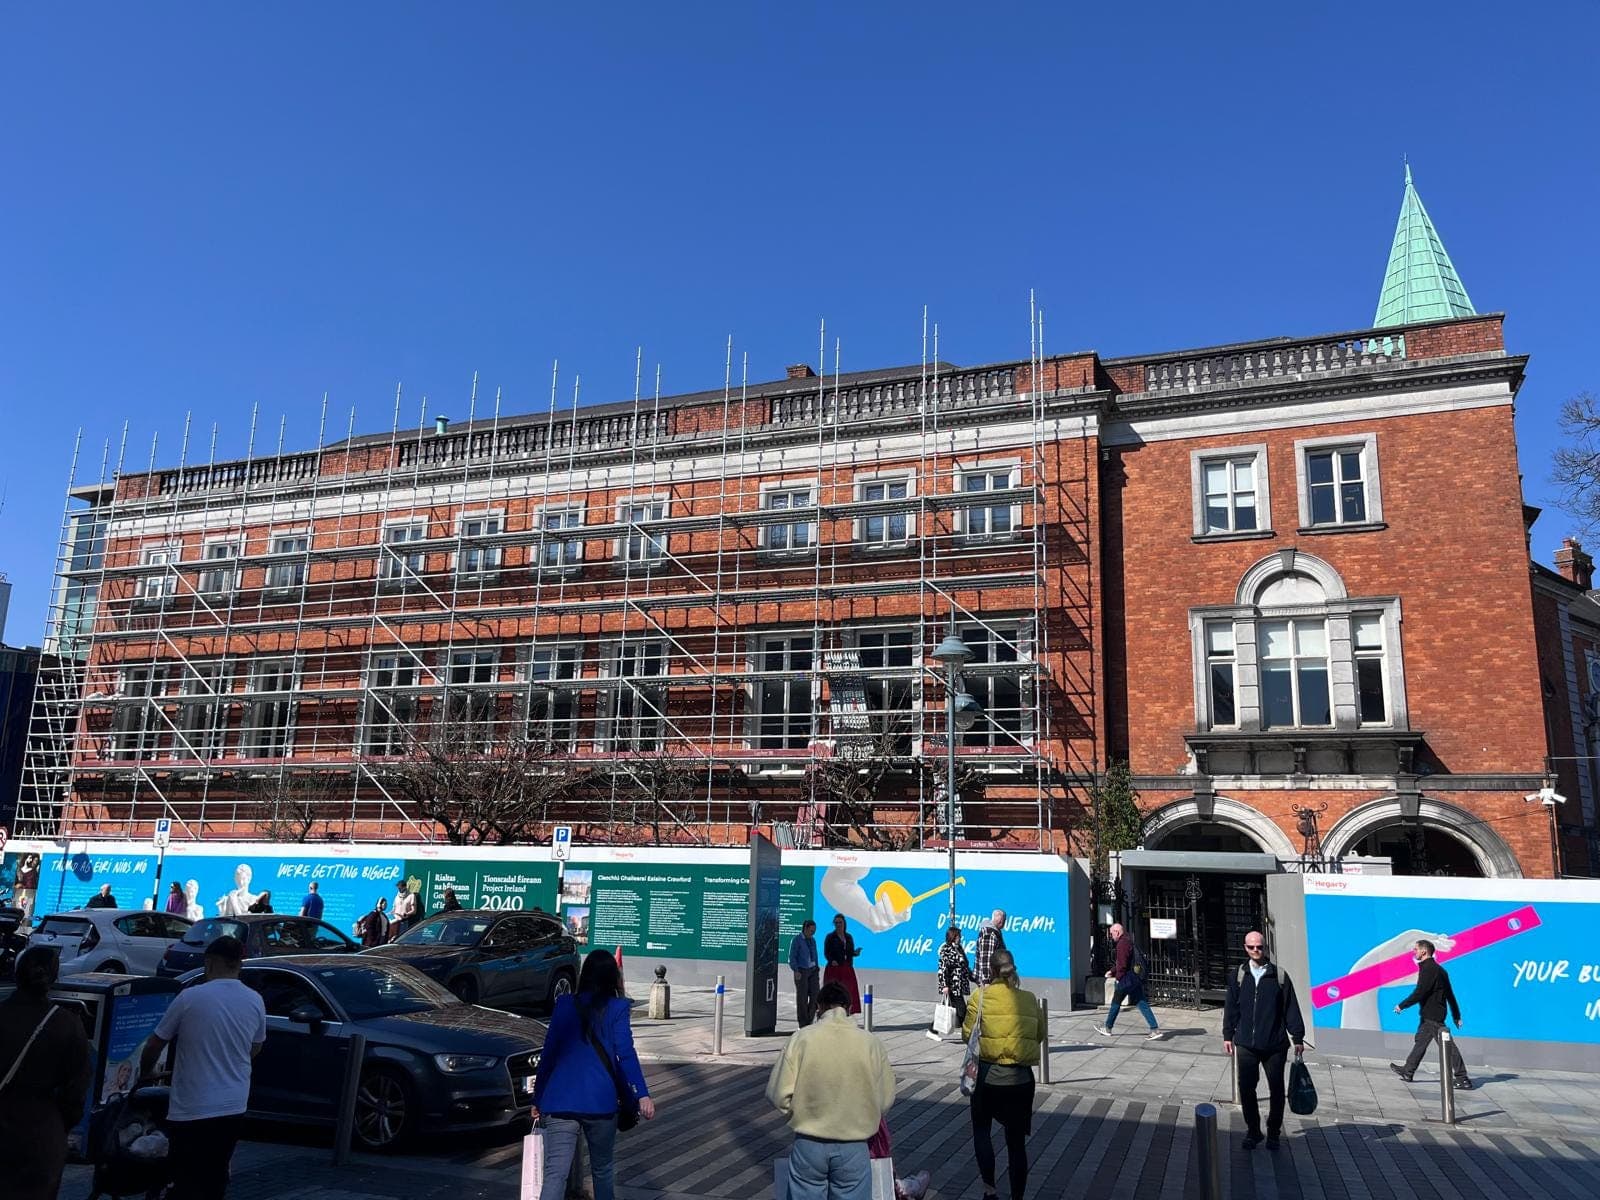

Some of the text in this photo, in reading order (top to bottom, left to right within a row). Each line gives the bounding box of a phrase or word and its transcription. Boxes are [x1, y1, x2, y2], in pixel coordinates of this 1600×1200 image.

[160, 821, 167, 831] P
[558, 829, 566, 841] P
[277, 863, 400, 881] WE'RE GETTING BIGGER
[434, 873, 456, 882] Rialtas
[482, 874, 542, 884] Tionscadal Éireann
[703, 876, 740, 885] Transforming
[779, 878, 796, 887] allery
[482, 884, 527, 893] Project Ireland
[1315, 881, 1347, 889] Hegarty
[433, 892, 470, 900] Govment
[480, 894, 524, 911] 2040
[896, 934, 933, 956] INÁR
[1512, 960, 1570, 988] YOUR
